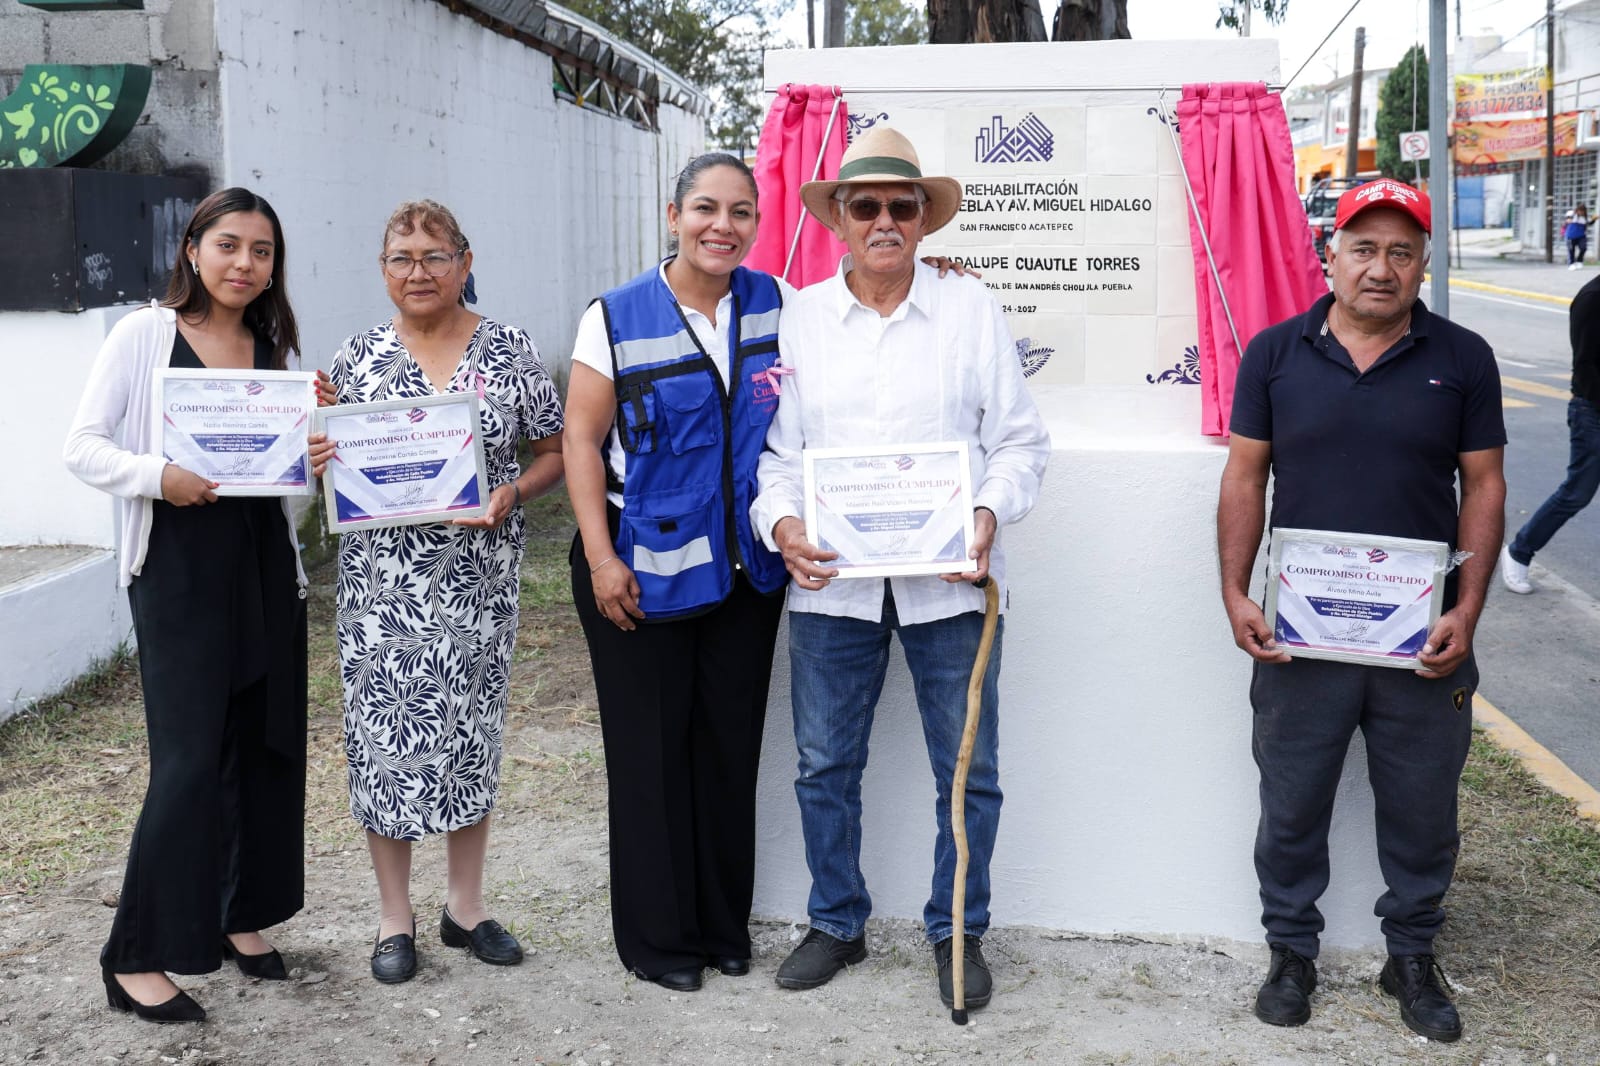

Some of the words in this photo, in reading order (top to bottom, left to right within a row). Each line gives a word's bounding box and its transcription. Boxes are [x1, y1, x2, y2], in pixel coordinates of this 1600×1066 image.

[965, 178, 1078, 196] REHABILITACIÓN
[1355, 183, 1419, 202] CAMPEONES
[959, 199, 995, 213] EBLA
[996, 199, 1006, 212] Y
[1008, 198, 1030, 212] AV.
[1033, 198, 1086, 212] MIGUEL
[1090, 198, 1152, 212] HIDALGO
[960, 223, 977, 231] SAN
[979, 223, 1027, 231] FRANCISCO
[1029, 223, 1074, 231] ACATEPEC
[948, 256, 1009, 269] DALUPE
[1015, 257, 1078, 272] CUAUTLE
[1086, 257, 1140, 271] TORRES
[1030, 281, 1061, 291] ANDRÉS
[170, 402, 243, 413] COMPROMISO
[246, 404, 302, 414] CUMPLIDO
[336, 435, 408, 449] COMPROMISO
[411, 428, 467, 441] CUMPLIDO
[821, 482, 895, 494] COMPROMISO
[898, 479, 955, 490] CUMPLIDO
[1287, 564, 1363, 580] COMPROMISO
[1366, 571, 1427, 586] CUMPLIDO
